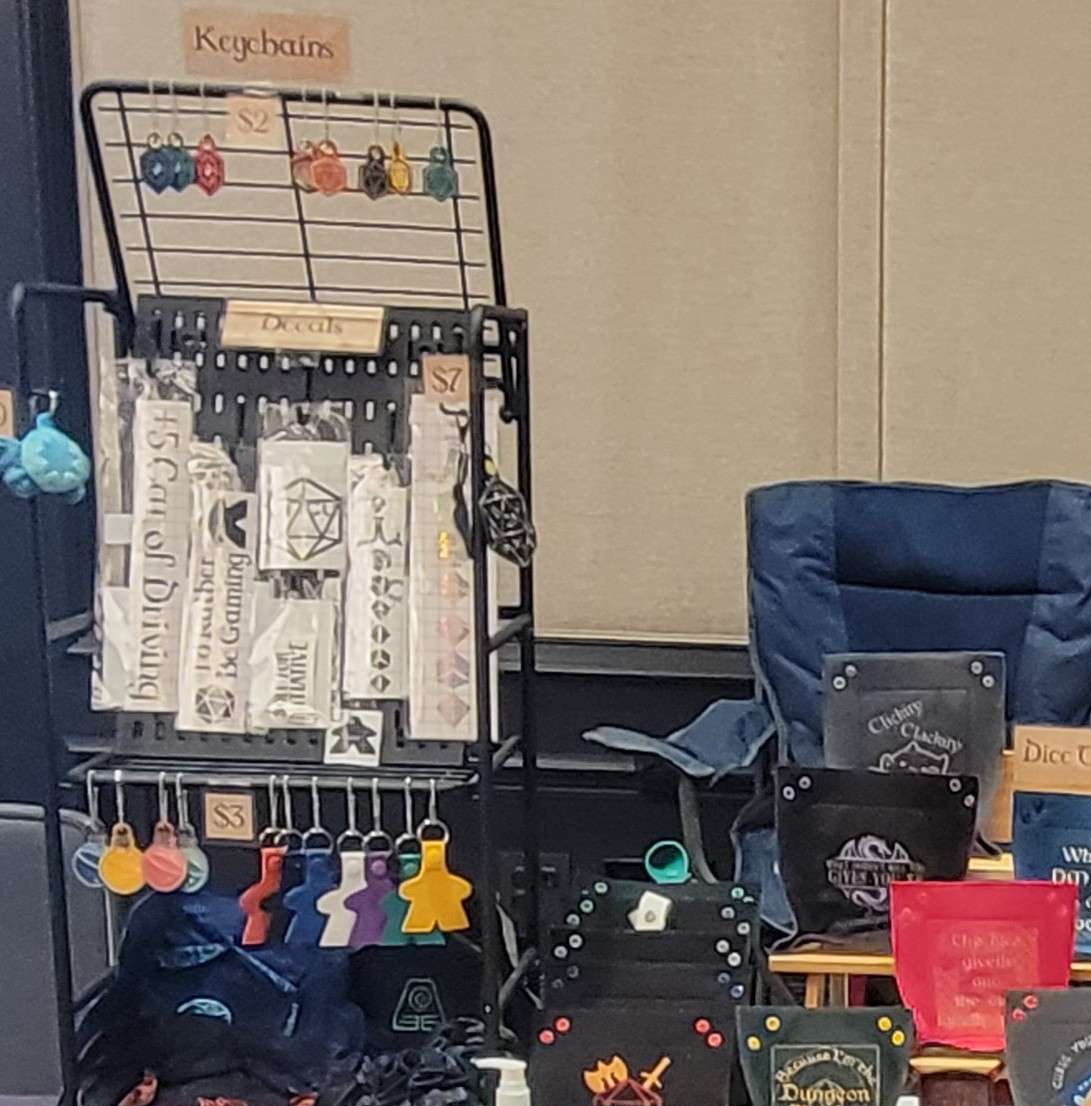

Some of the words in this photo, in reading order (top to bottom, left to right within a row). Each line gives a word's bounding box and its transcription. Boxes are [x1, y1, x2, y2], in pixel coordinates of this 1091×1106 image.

[194, 24, 335, 64] Keychains
[260, 312, 344, 336] Decals
[219, 552, 252, 646] Gaming
[130, 576, 180, 701] Driving
[1023, 738, 1071, 764] Dice
[777, 1082, 871, 1106] Dungeon
